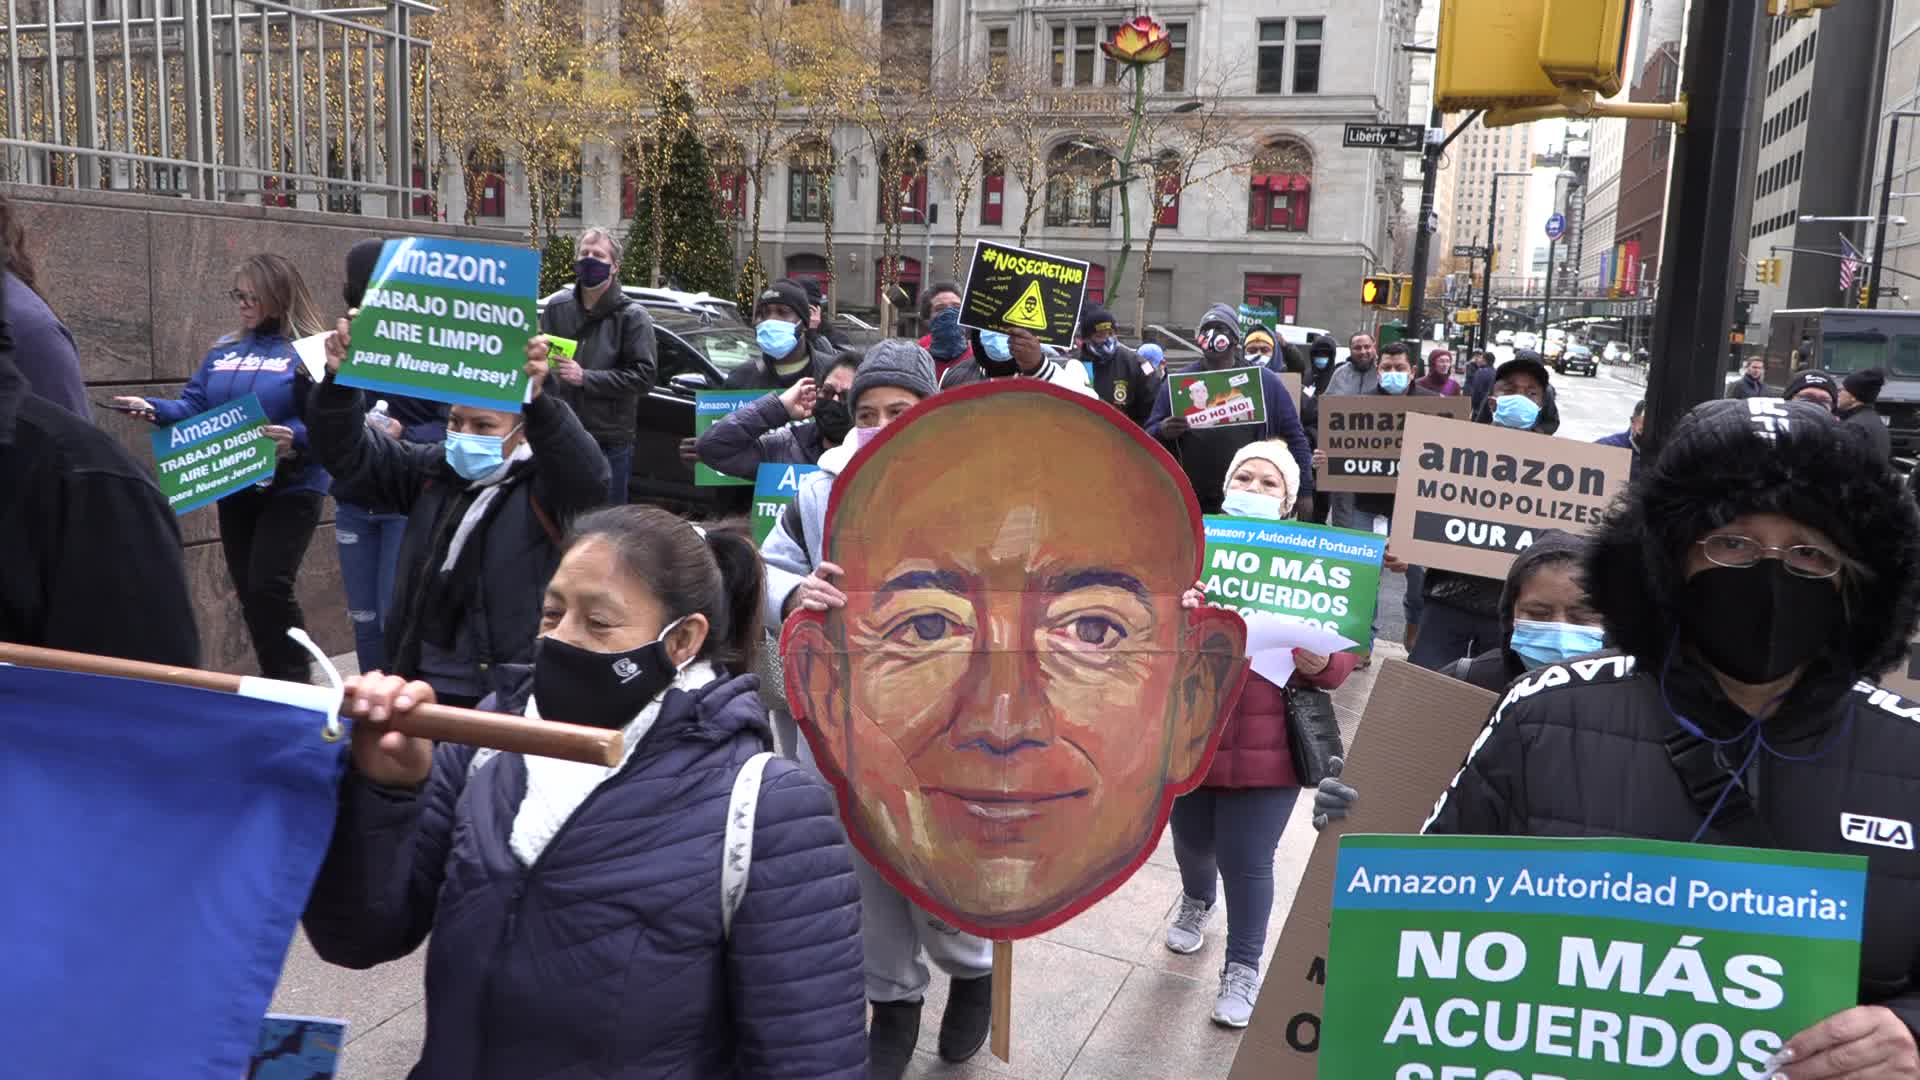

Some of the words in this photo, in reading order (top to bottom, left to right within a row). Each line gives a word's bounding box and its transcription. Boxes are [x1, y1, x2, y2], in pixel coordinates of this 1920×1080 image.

[1350, 129, 1387, 146] Liberty
[374, 319, 422, 343] AIRE
[428, 326, 503, 355] LIMPIO
[352, 350, 392, 367] para
[395, 352, 450, 376] Nueva
[451, 362, 518, 388] Jersey!
[698, 400, 730, 410] Amazon
[1190, 414, 1207, 424] HO
[1209, 408, 1226, 418] HO
[1229, 402, 1249, 413] NO!
[1329, 412, 1406, 431] amaz
[170, 405, 248, 448] Amazon:
[1329, 436, 1403, 449] MONOPO
[160, 443, 221, 474] TRABAJO
[179, 464, 209, 484] AIRE
[212, 446, 256, 473] LIMPIO
[1344, 459, 1383, 473] OUR
[1418, 441, 1606, 496] amazon
[195, 474, 230, 493] Nueva
[756, 502, 787, 517] TRA
[1417, 479, 1601, 525] MONOPOLIZES
[1204, 526, 1245, 540] Amazon
[1246, 532, 1255, 543] y
[1256, 530, 1317, 548] Autoridad
[1319, 538, 1378, 559] Portuaria:
[1445, 518, 1505, 548] OUR
[1212, 549, 1260, 574] NO
[1269, 557, 1351, 590] MÁS
[1203, 574, 1348, 617] ACUERDOS
[1847, 817, 1908, 845] FILA
[1347, 866, 1477, 895] Amazon
[1484, 876, 1504, 903] y
[1510, 868, 1677, 907] Autoridad
[1688, 879, 1848, 921] Portuaria:
[1397, 930, 1527, 983] NO
[1558, 935, 1784, 1010] MÁS
[1383, 996, 1783, 1080] ACUERDOS
